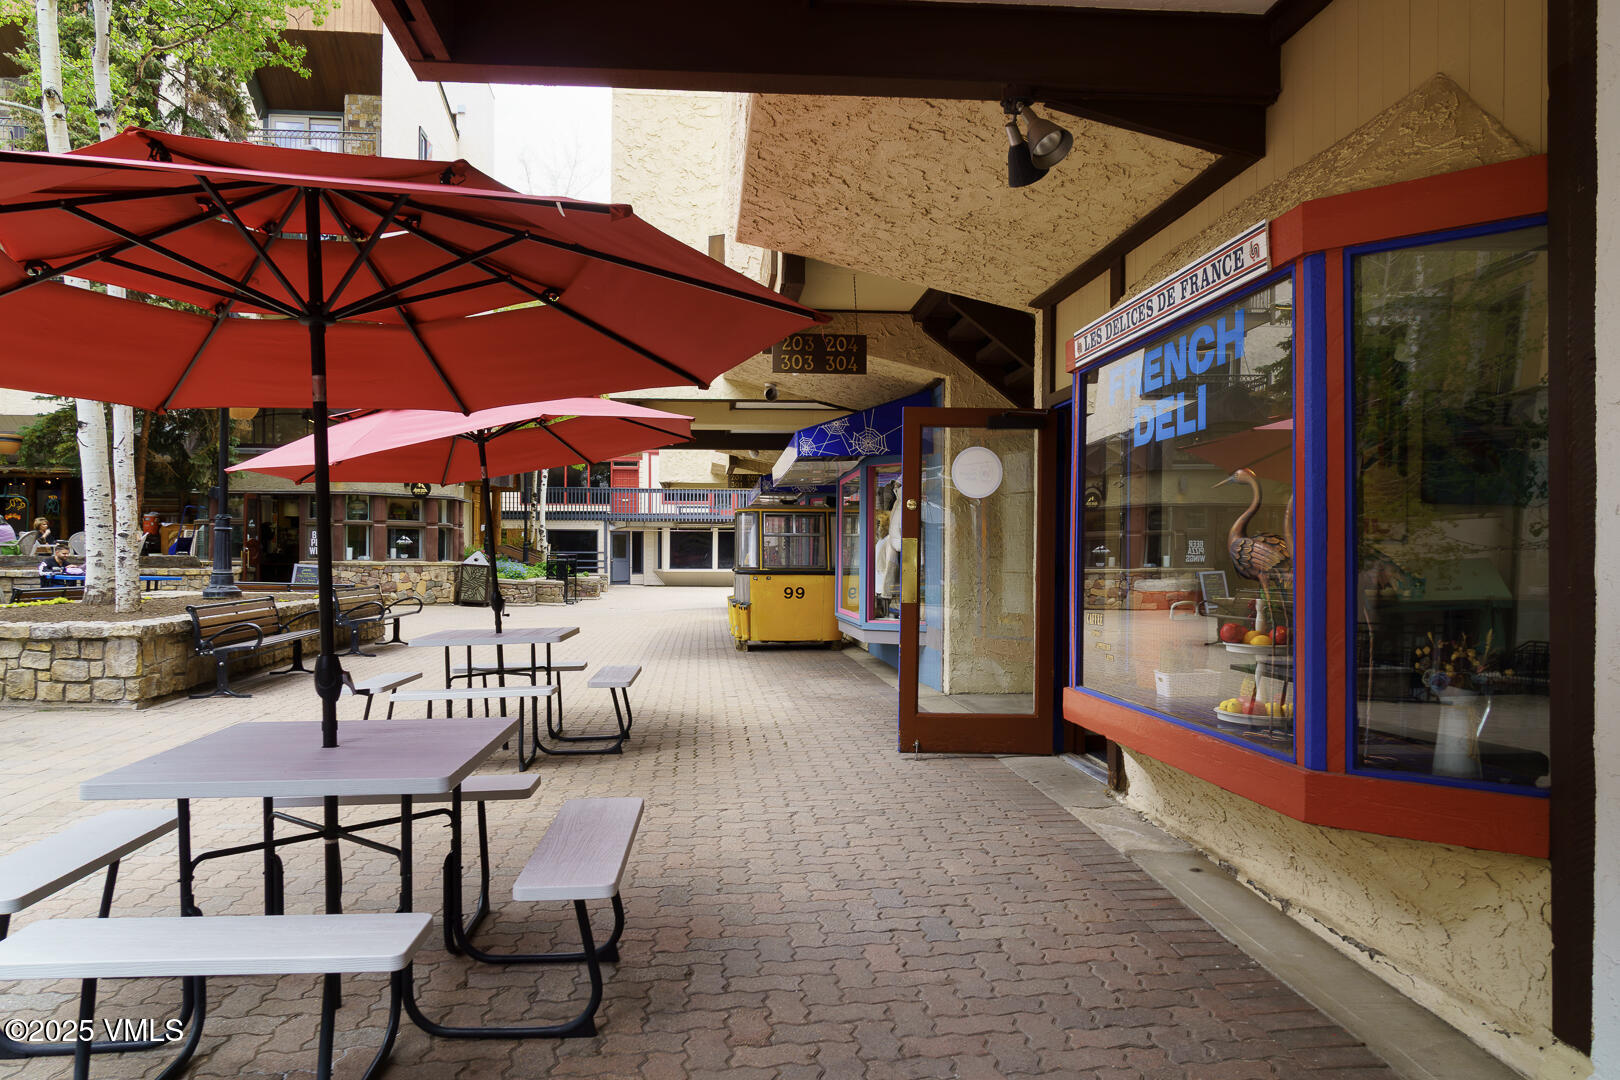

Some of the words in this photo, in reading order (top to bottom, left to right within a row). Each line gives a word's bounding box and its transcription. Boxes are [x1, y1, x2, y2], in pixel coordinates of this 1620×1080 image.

[1084, 327, 1102, 352] LES
[1105, 299, 1153, 341] DELICES
[1157, 287, 1176, 313] DE
[1180, 246, 1245, 301] FRANCE
[781, 354, 815, 370] 303
[825, 356, 858, 371] 304
[782, 336, 815, 351] 203
[826, 337, 858, 352] 204
[1109, 308, 1245, 407] FRENCH
[1133, 383, 1207, 448] DELI
[783, 586, 805, 599] 99
